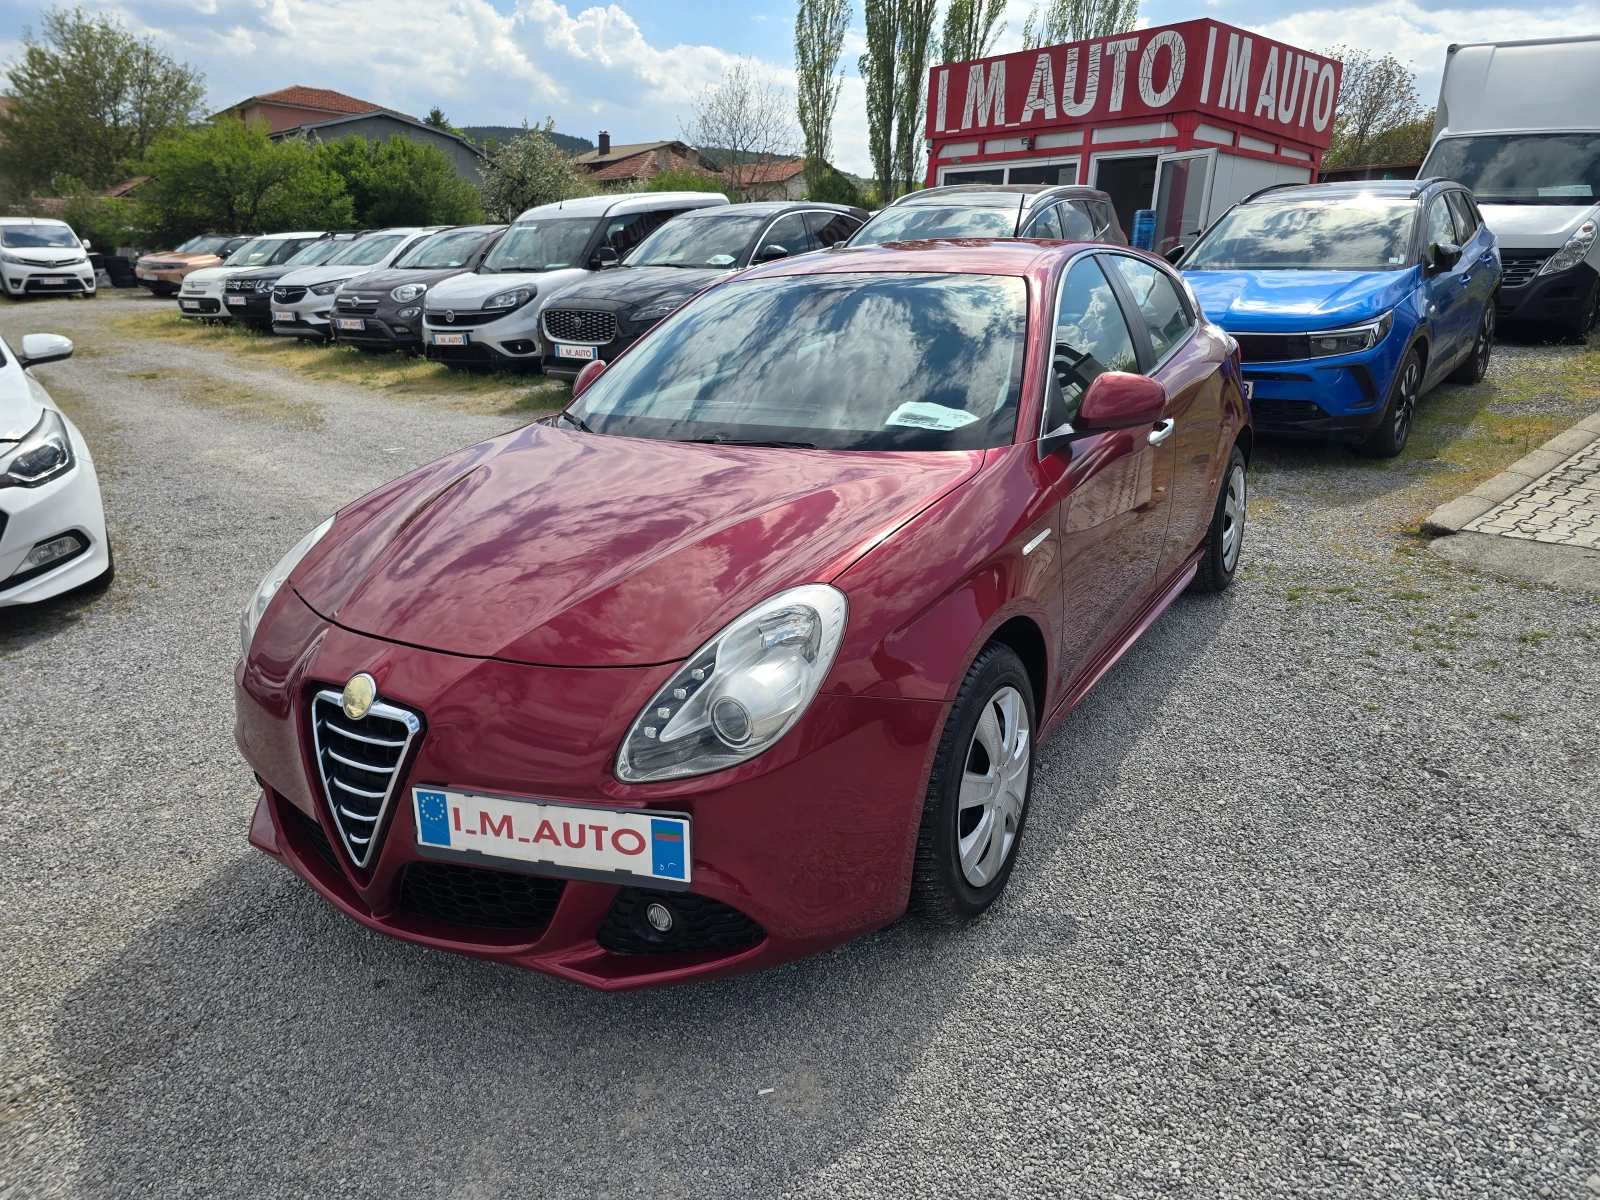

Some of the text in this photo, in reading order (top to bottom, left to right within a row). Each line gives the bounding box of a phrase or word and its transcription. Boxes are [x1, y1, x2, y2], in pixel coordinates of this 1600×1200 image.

[1200, 26, 1335, 133] I M AUTO
[560, 347, 592, 358] I_M_AUTO
[453, 807, 646, 856] I_M_AUTO
